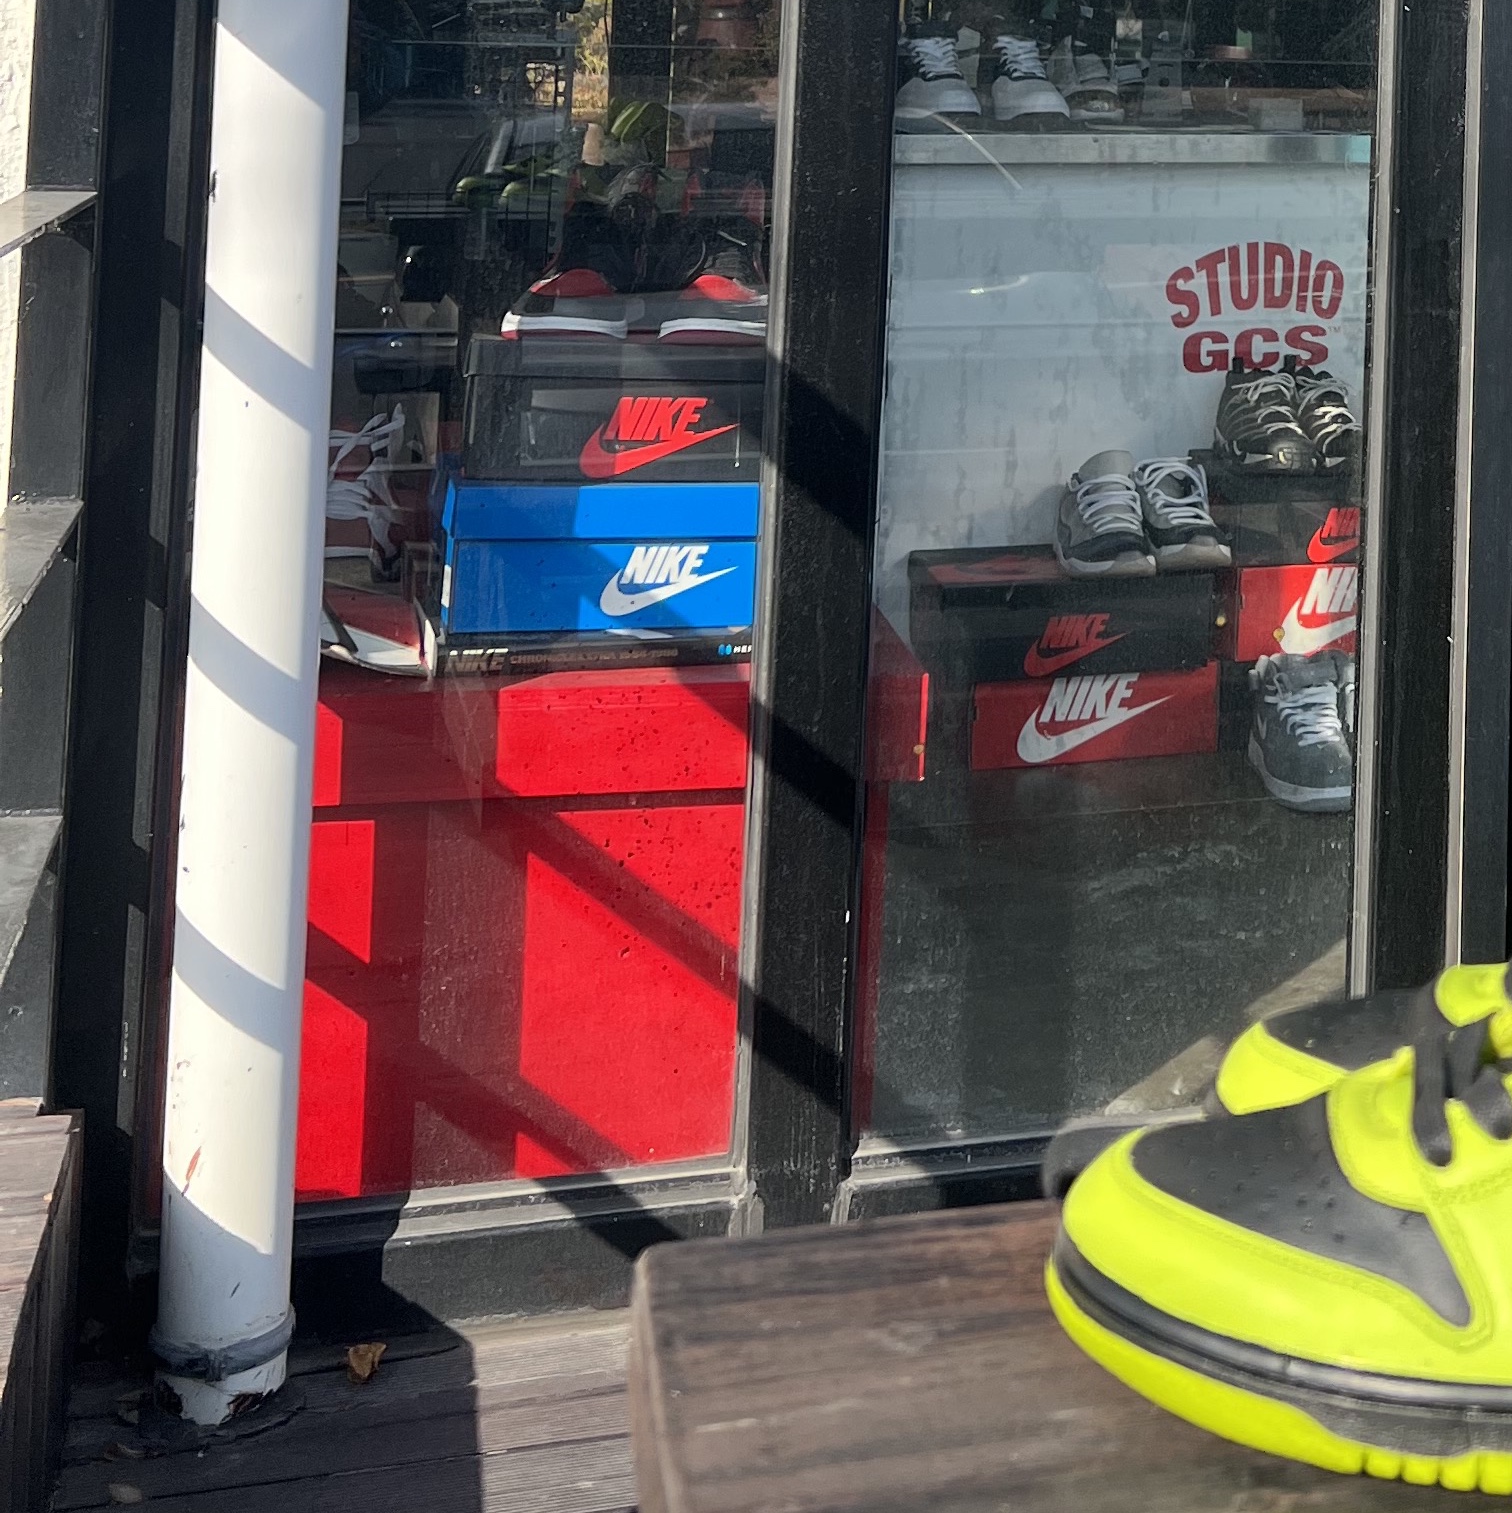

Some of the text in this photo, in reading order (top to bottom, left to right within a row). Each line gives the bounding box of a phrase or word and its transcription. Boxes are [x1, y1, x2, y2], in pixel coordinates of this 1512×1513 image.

[1166, 241, 1344, 328] STUDIO
[1183, 325, 1328, 373] GCS
[604, 397, 709, 440] NIKE
[621, 545, 710, 585] NIKE
[1039, 613, 1110, 649] NIKE
[1039, 673, 1140, 723] NIKE
